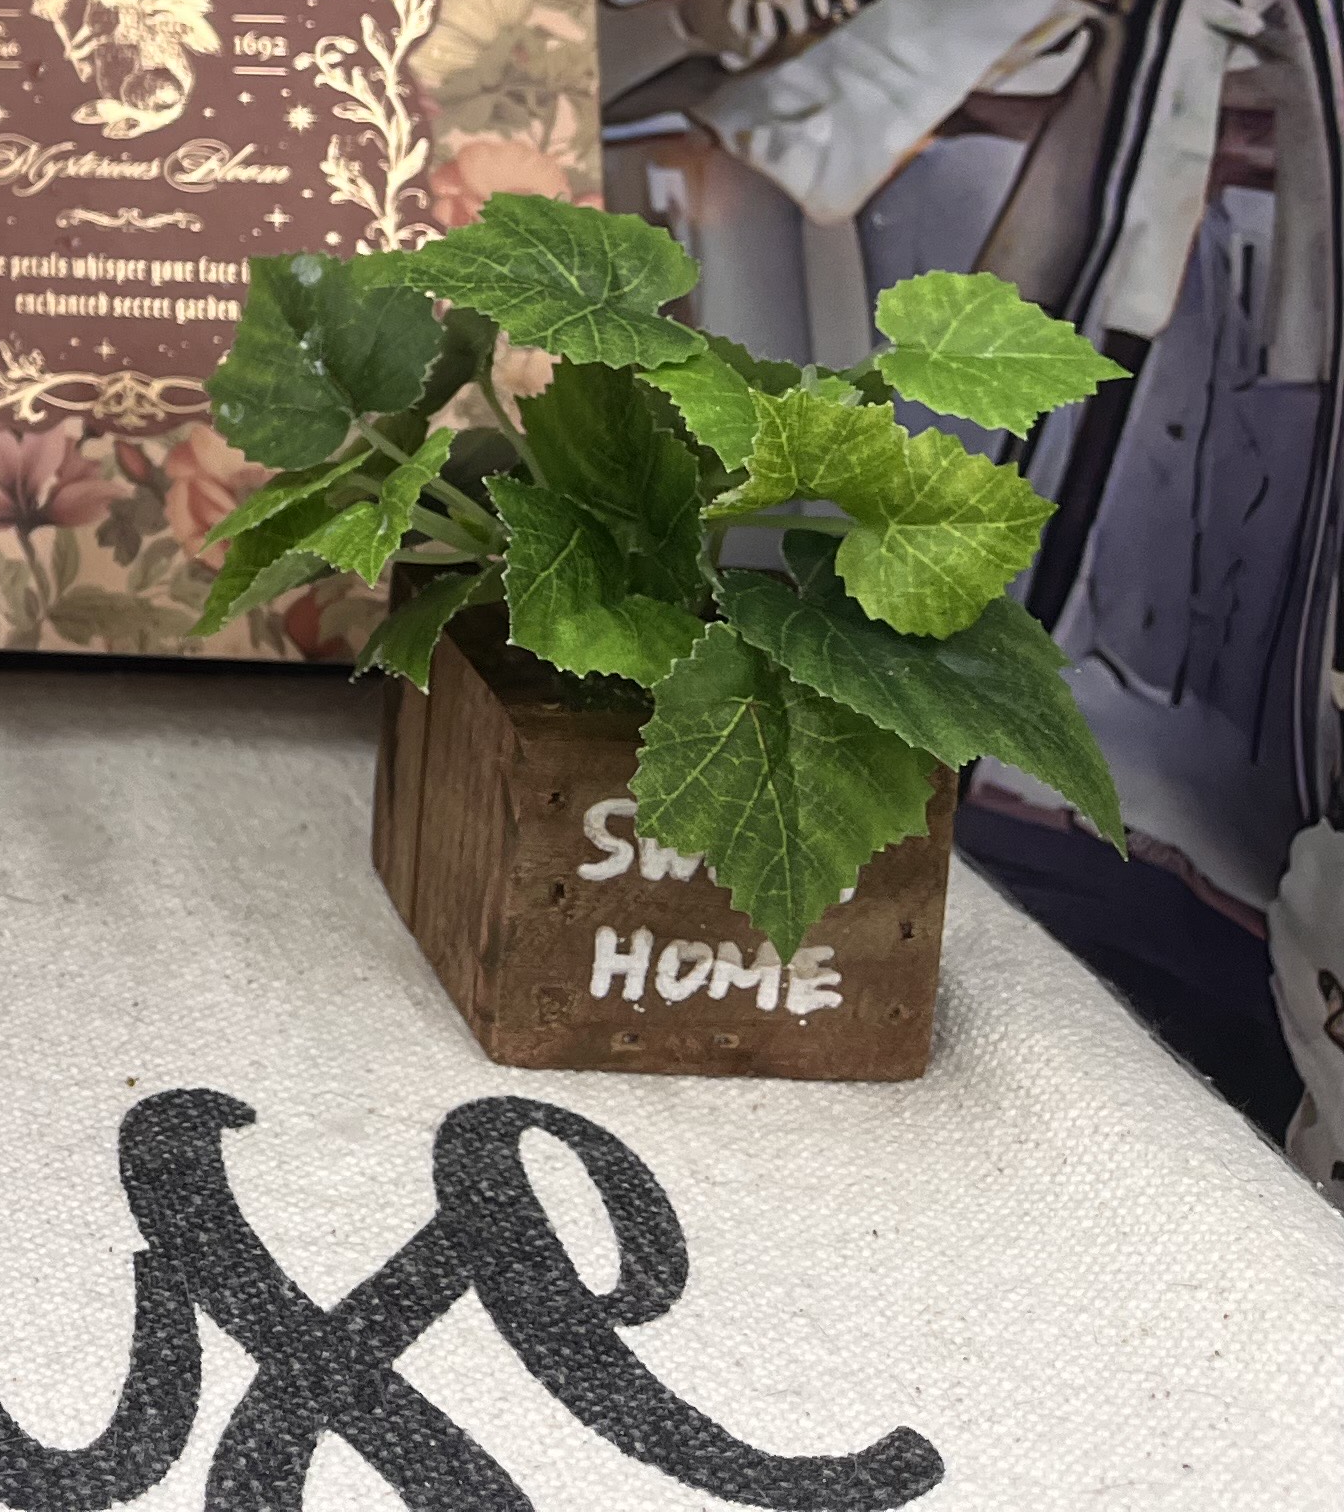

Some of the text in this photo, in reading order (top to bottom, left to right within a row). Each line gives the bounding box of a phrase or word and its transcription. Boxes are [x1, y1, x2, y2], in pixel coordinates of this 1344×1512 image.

[232, 34, 288, 63] 1692
[9, 251, 69, 281] petals
[71, 252, 148, 285] whisper
[15, 288, 111, 317] enchanted
[112, 294, 173, 320] secret
[589, 924, 844, 1016] HOME
